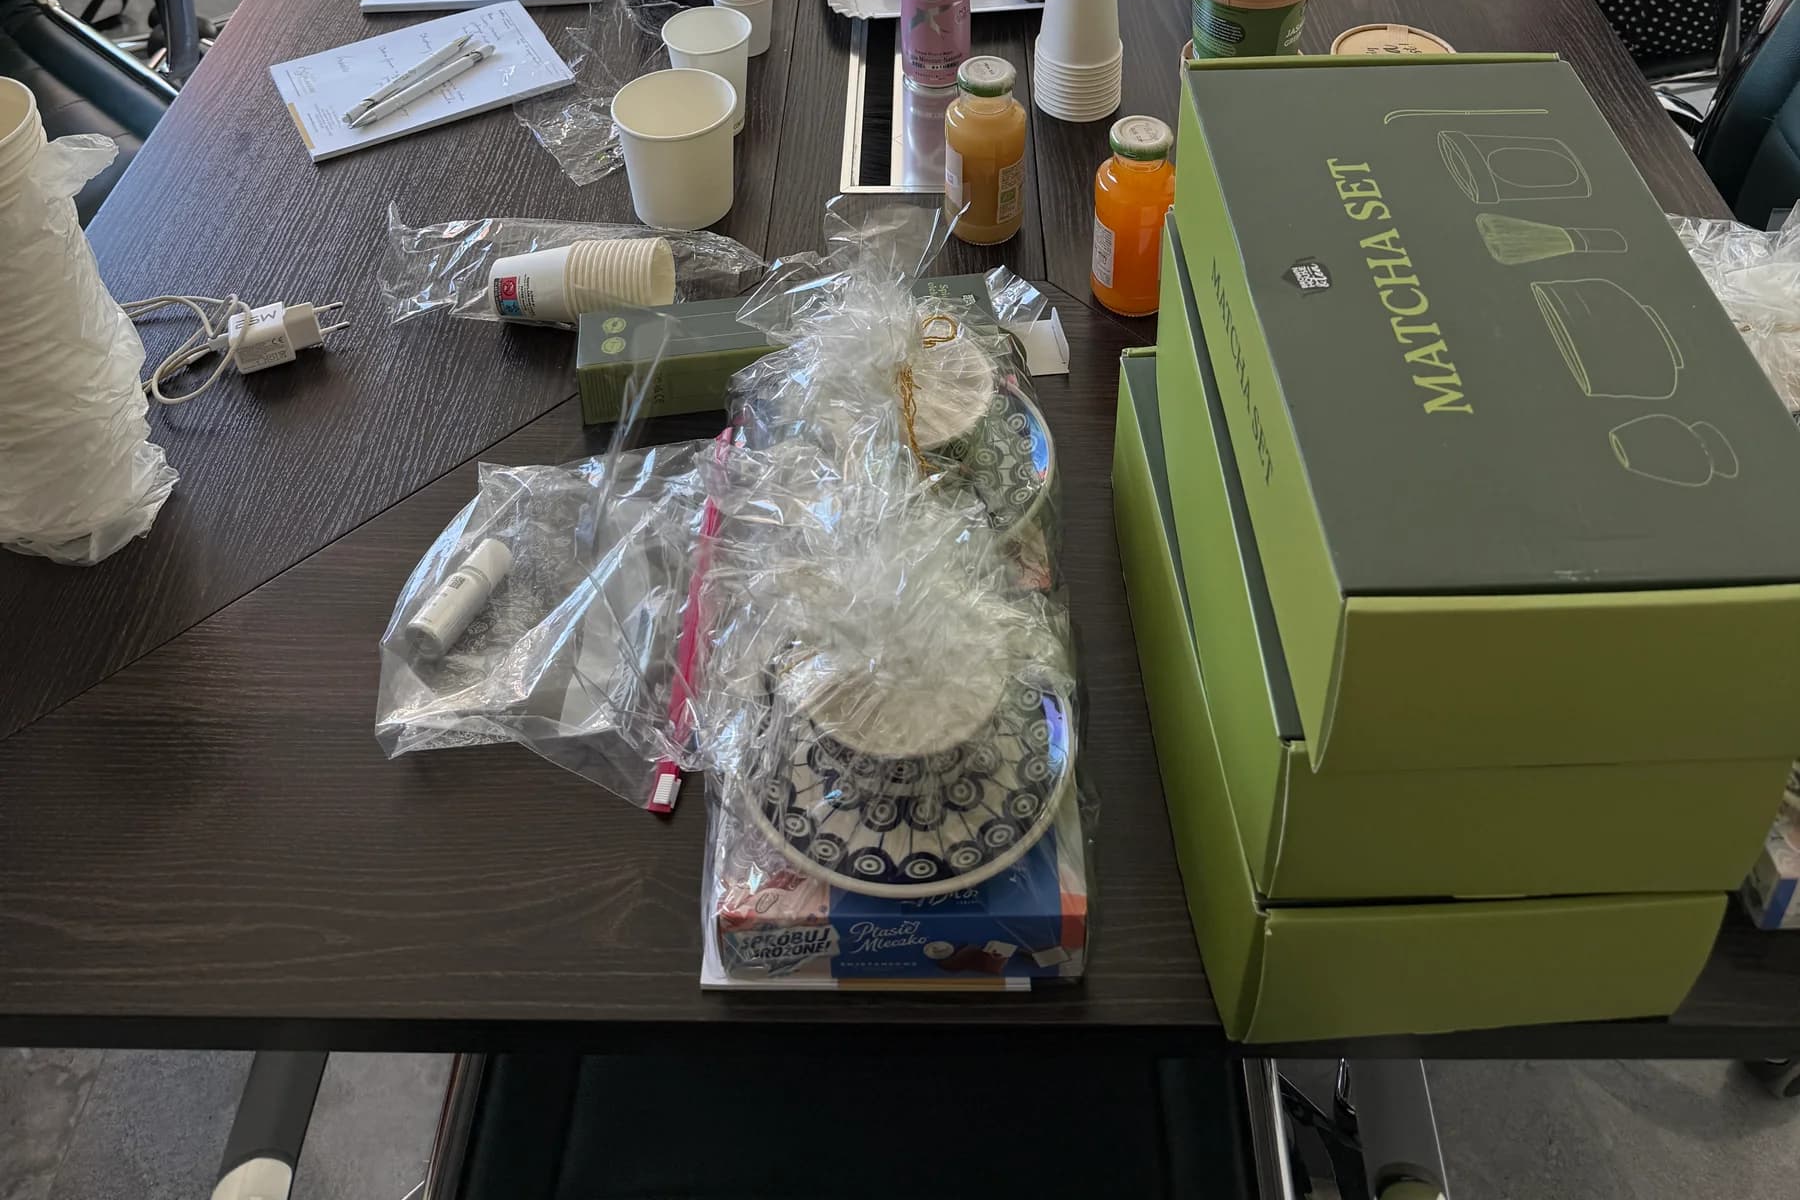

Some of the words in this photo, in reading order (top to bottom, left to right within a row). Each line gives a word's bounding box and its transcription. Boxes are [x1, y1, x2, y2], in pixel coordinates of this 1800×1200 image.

[1326, 157, 1392, 222] SET
[1360, 227, 1475, 415] MATCHA
[1211, 255, 1251, 416] MATCHA
[1251, 404, 1274, 487] SET
[754, 940, 833, 960] ROŻONE!
[849, 919, 921, 943] Ptasie
[849, 934, 928, 954] Mleczko
